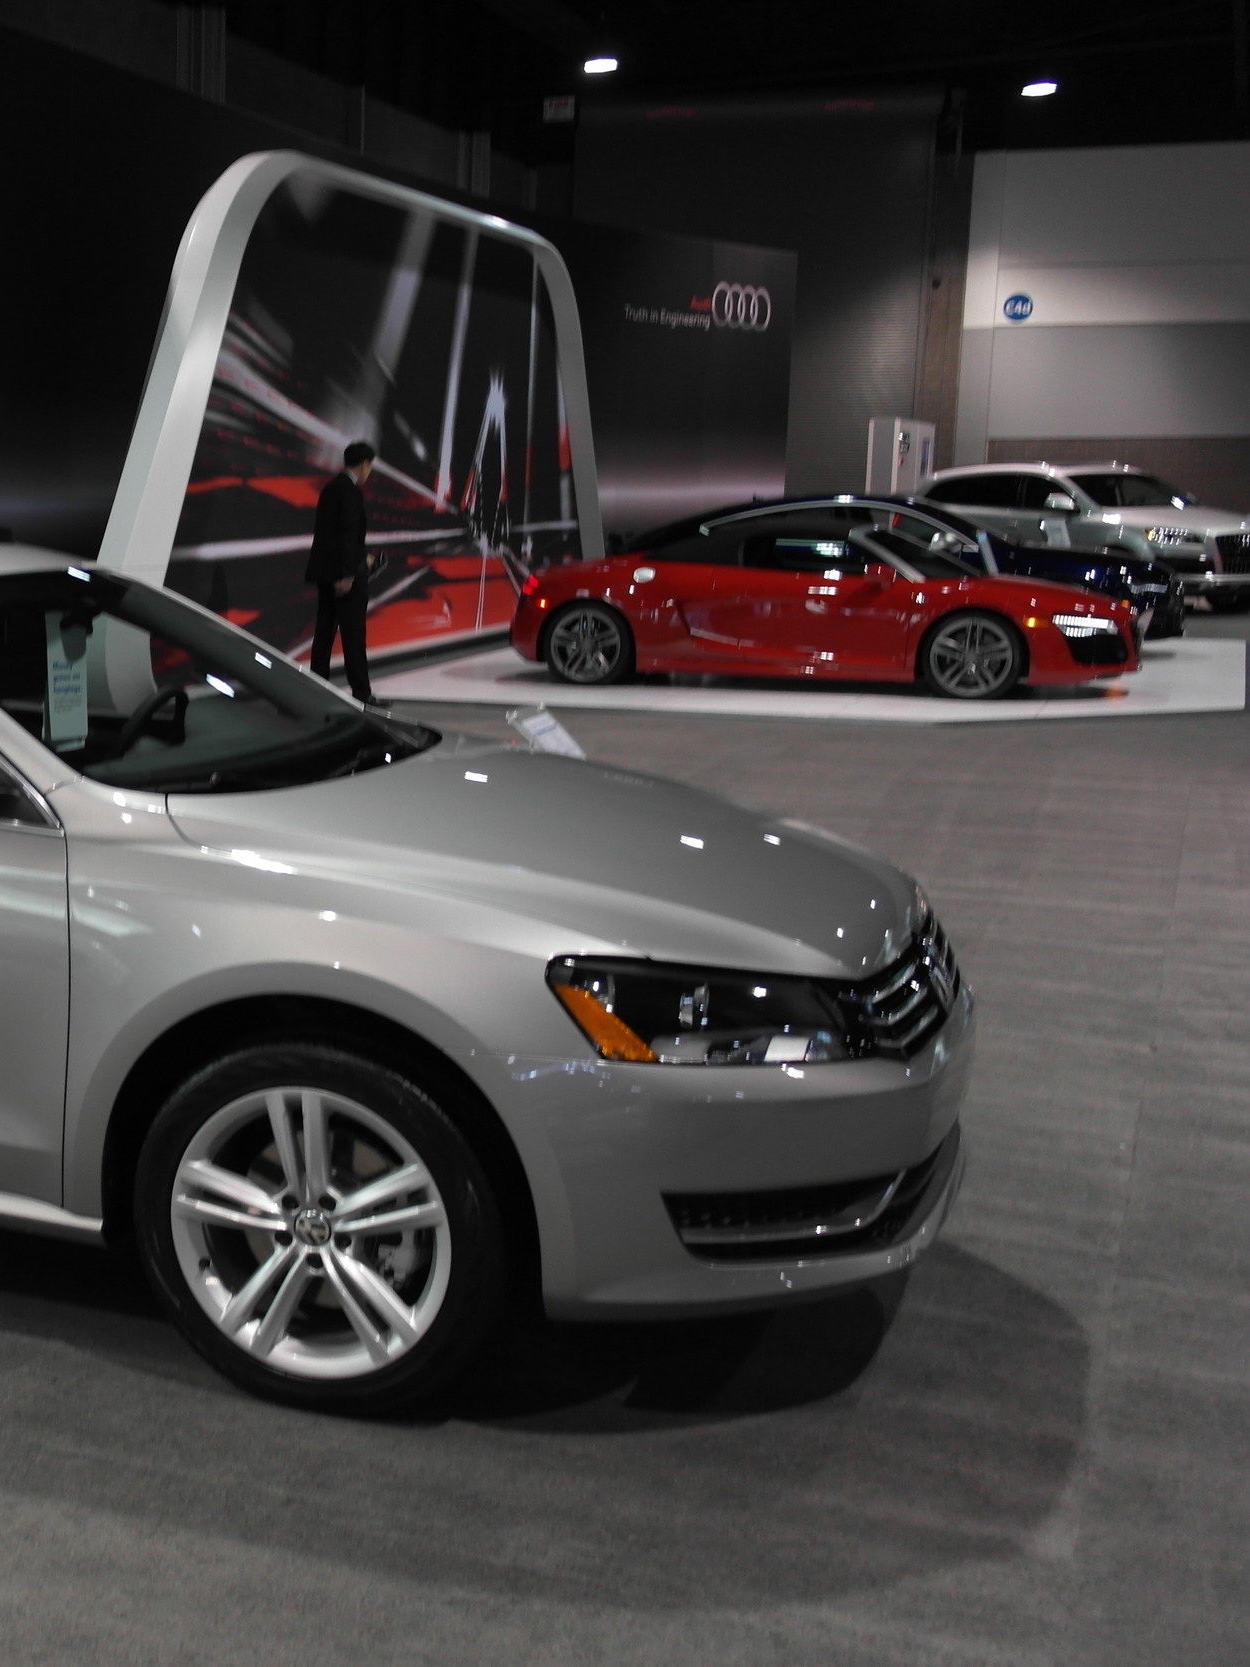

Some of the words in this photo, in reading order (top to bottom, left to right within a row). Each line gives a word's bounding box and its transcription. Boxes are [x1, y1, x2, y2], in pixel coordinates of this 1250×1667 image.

[625, 303, 648, 322] Truth
[650, 307, 659, 323] in
[660, 307, 711, 331] Engineering
